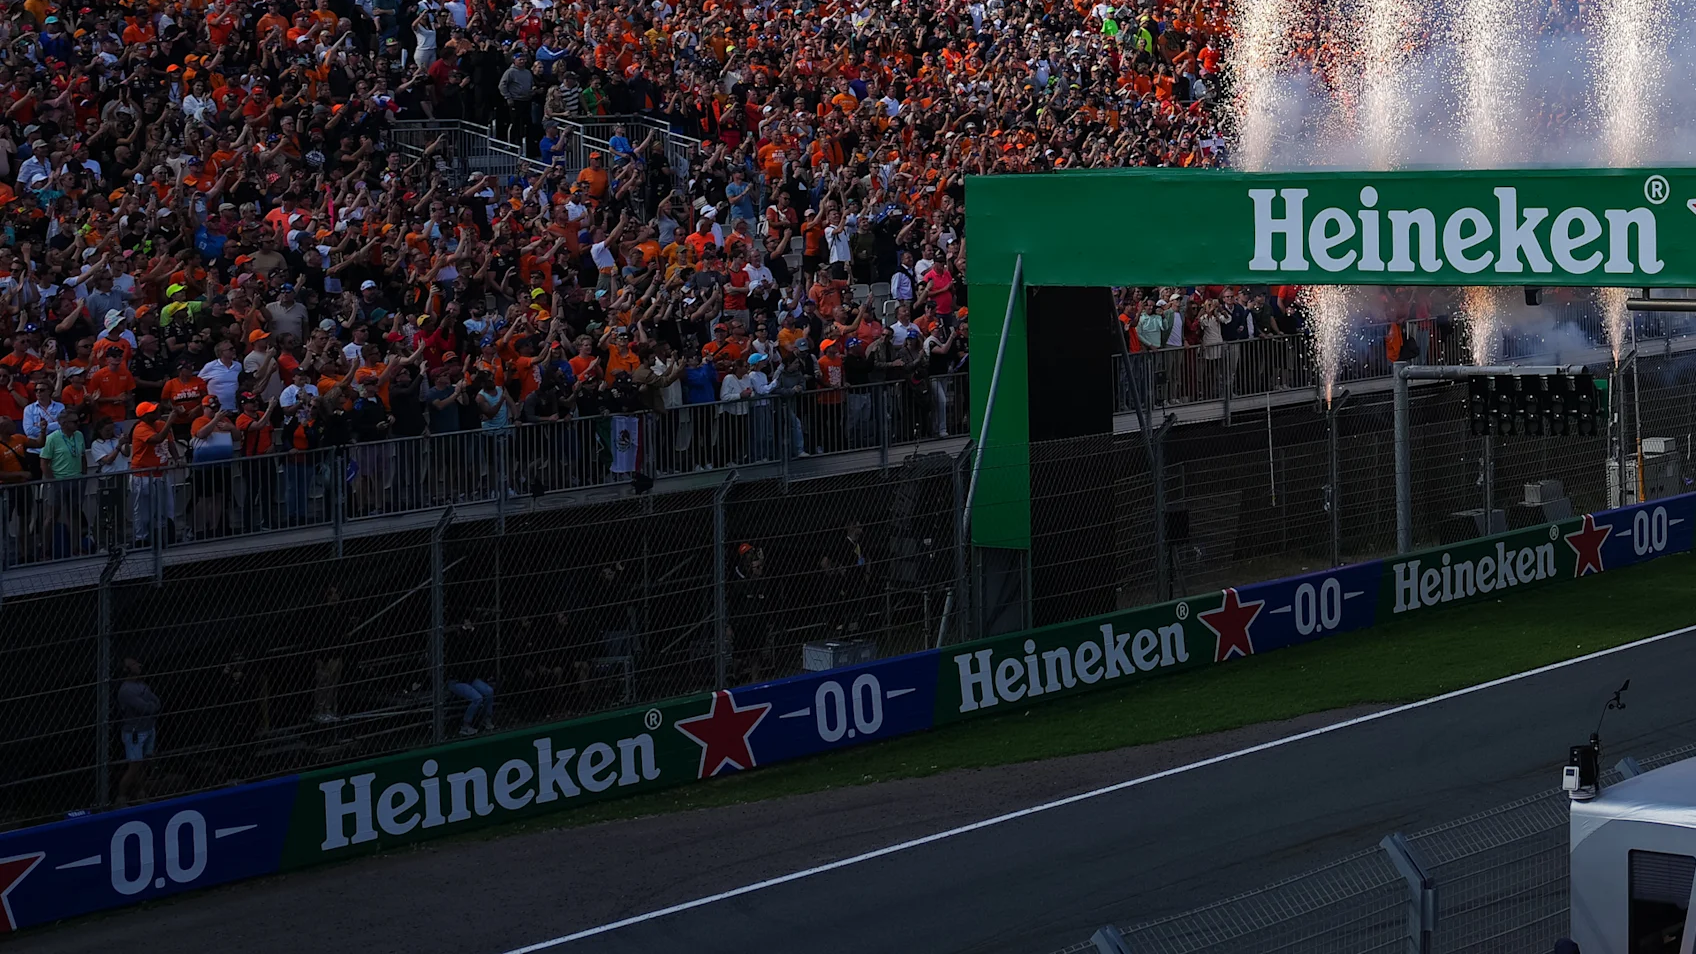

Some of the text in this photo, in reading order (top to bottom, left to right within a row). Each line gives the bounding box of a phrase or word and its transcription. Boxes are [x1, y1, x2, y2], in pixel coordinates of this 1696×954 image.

[1248, 186, 1665, 274] Heineken
[1634, 506, 1668, 556] 0.0
[1294, 577, 1343, 635] 0.0
[1393, 537, 1556, 614] Heineken
[814, 672, 884, 742] 0.0
[954, 621, 1189, 713] Heineken
[319, 730, 662, 851] Heineken
[110, 809, 208, 895] 0.0
